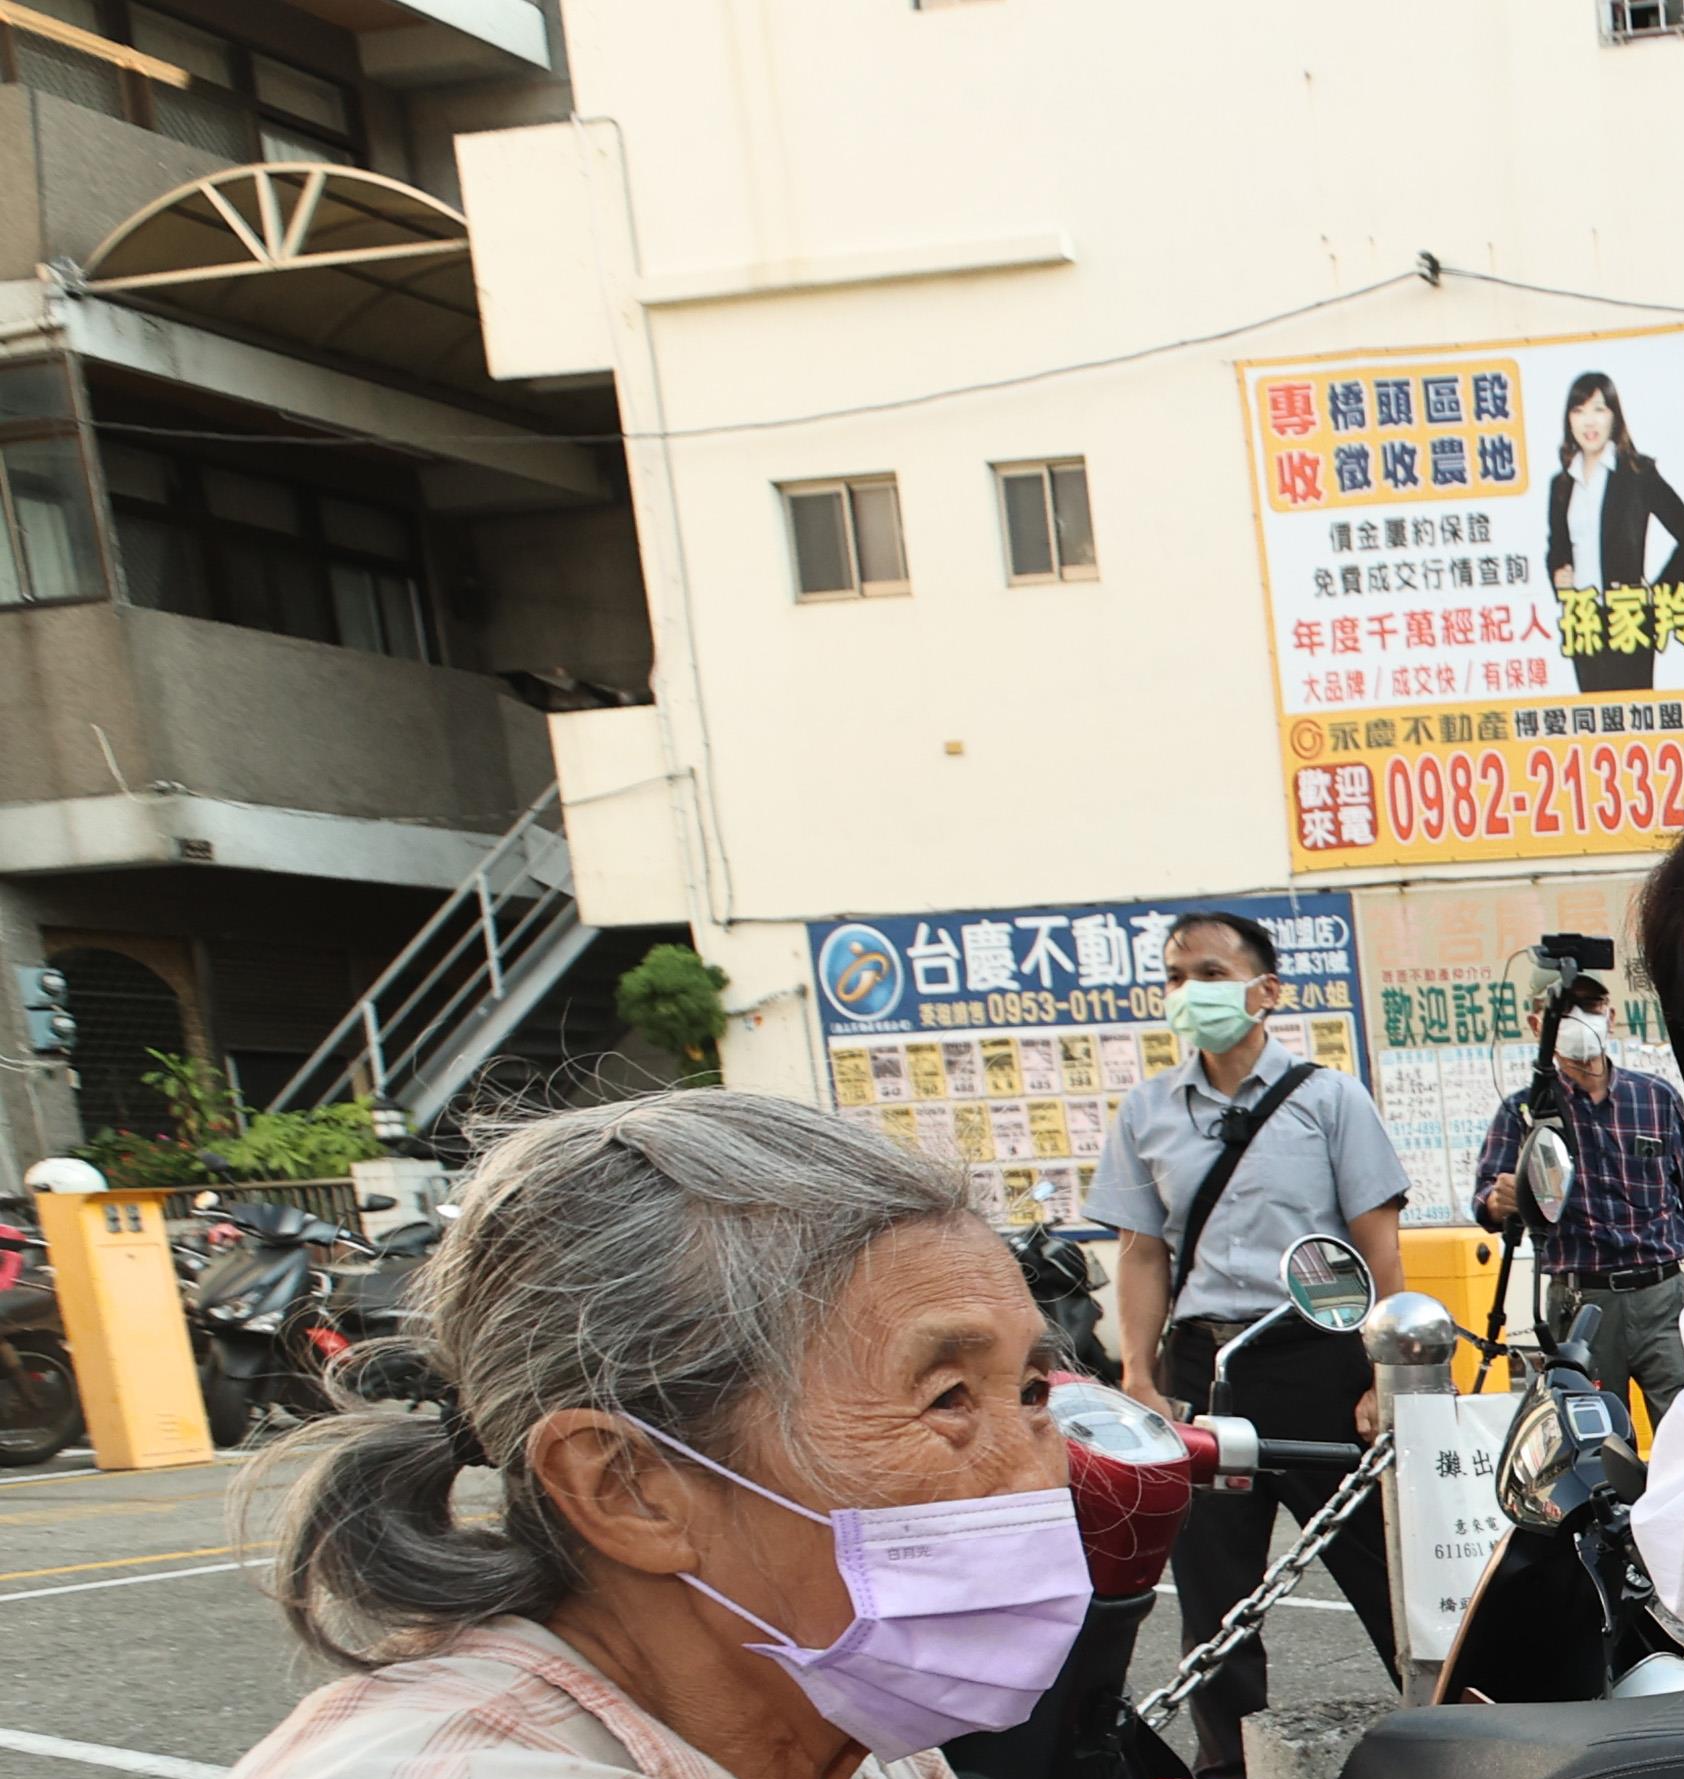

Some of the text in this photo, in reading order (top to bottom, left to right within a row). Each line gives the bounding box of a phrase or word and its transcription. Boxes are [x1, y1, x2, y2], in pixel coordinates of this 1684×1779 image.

[1329, 372, 1511, 432] 橋頭區段
[1334, 434, 1517, 493] 徵收農地
[1313, 553, 1530, 599] 免費成交行情查詢
[1292, 602, 1552, 656] 年度千萬經紀人
[1328, 711, 1509, 752] 永慶不動產
[1297, 764, 1372, 810] 歡迎
[1301, 804, 1378, 850] 來電
[906, 909, 1178, 996] 台慶不動產
